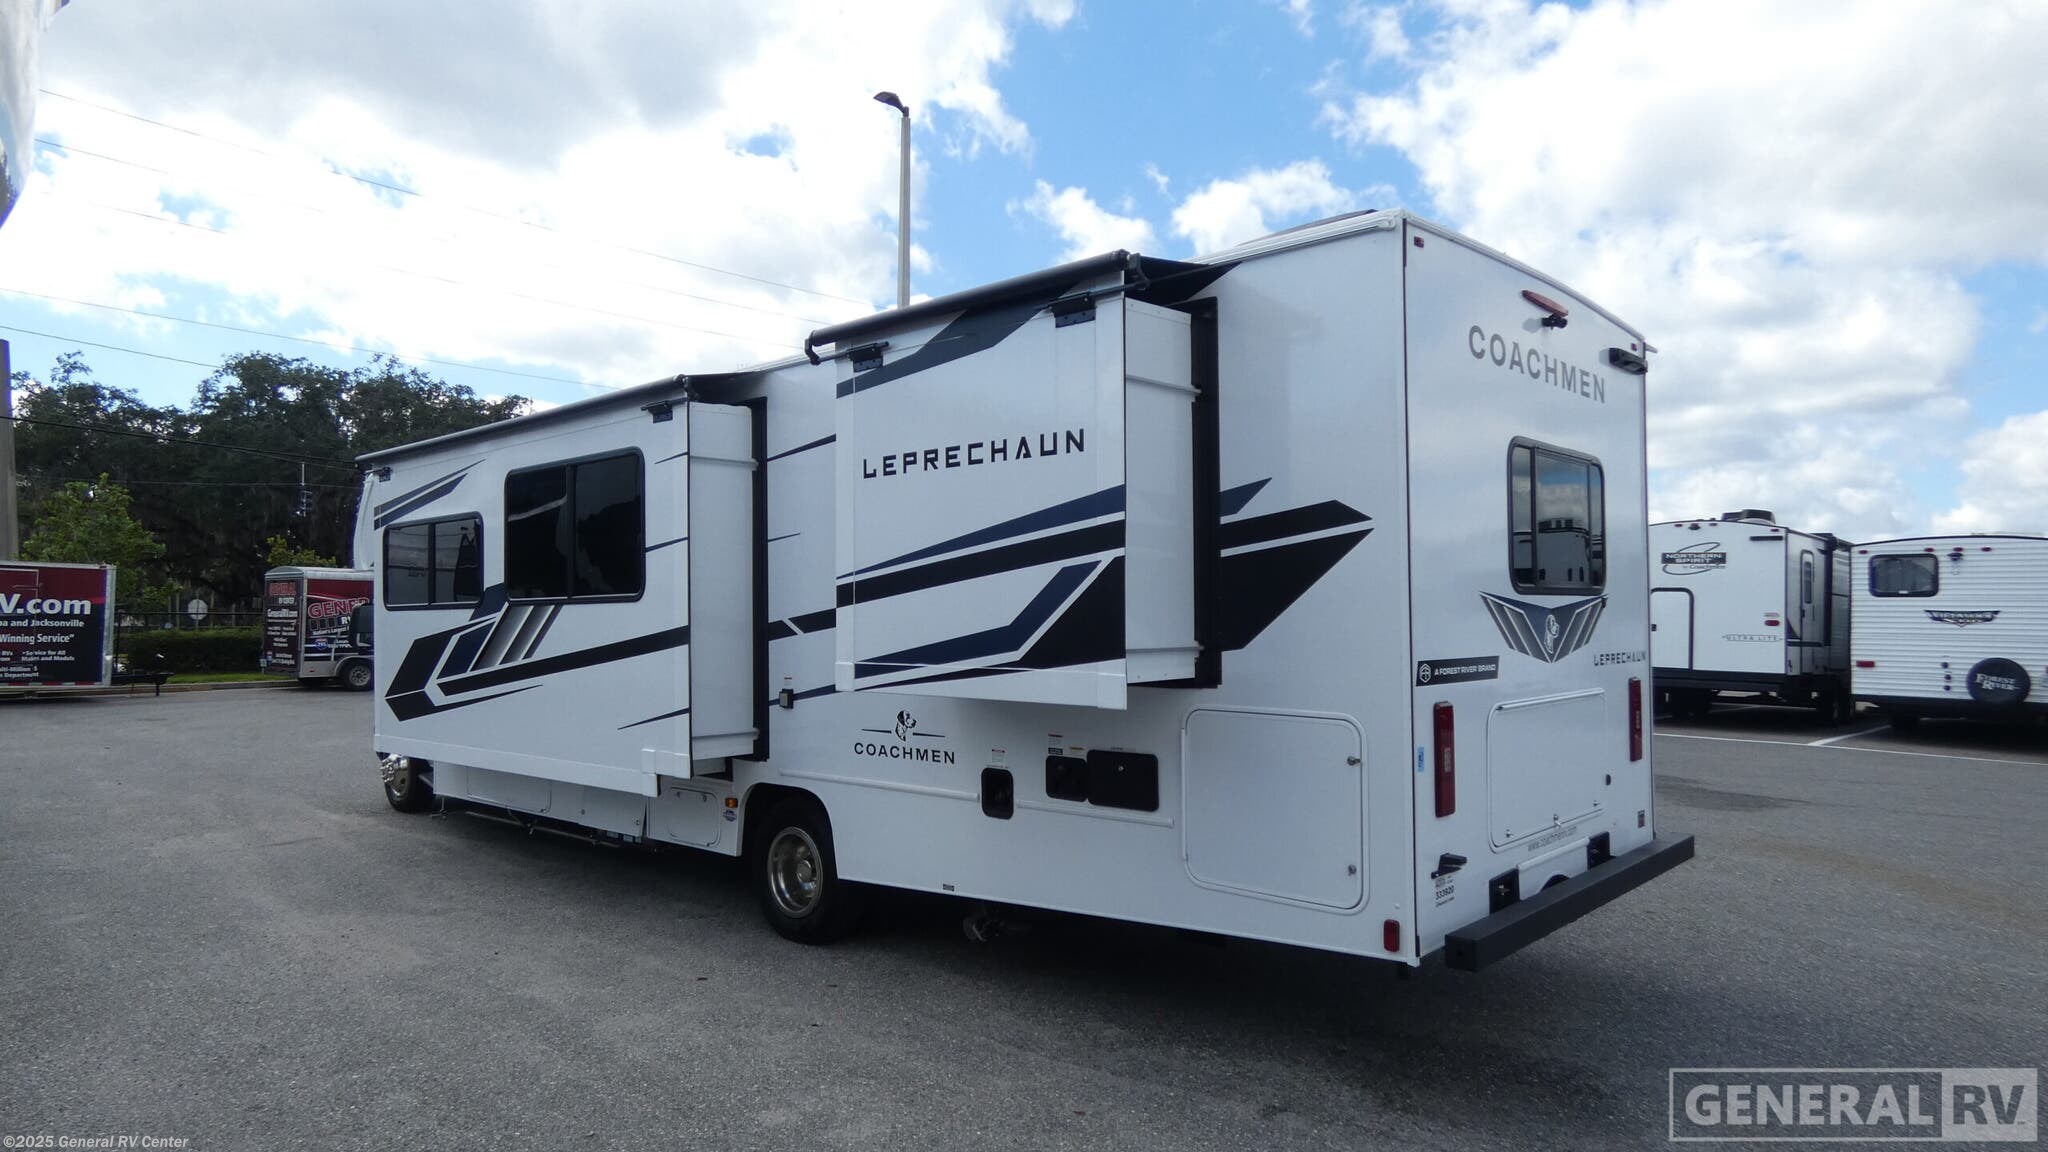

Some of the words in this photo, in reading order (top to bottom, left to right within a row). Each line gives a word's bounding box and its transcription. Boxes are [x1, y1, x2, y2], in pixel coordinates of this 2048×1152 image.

[1468, 325, 1605, 403] COACHMEN
[863, 428, 1084, 479] LEPRECHAUN
[10, 619, 28, 627] and
[30, 619, 85, 628] Jacksonville
[1594, 651, 1647, 666] LEPRECHAUN
[1440, 667, 1460, 675] FOREST
[1461, 666, 1477, 674] RIVER
[1478, 664, 1496, 672] BRAND
[854, 742, 955, 765] COACHMEN
